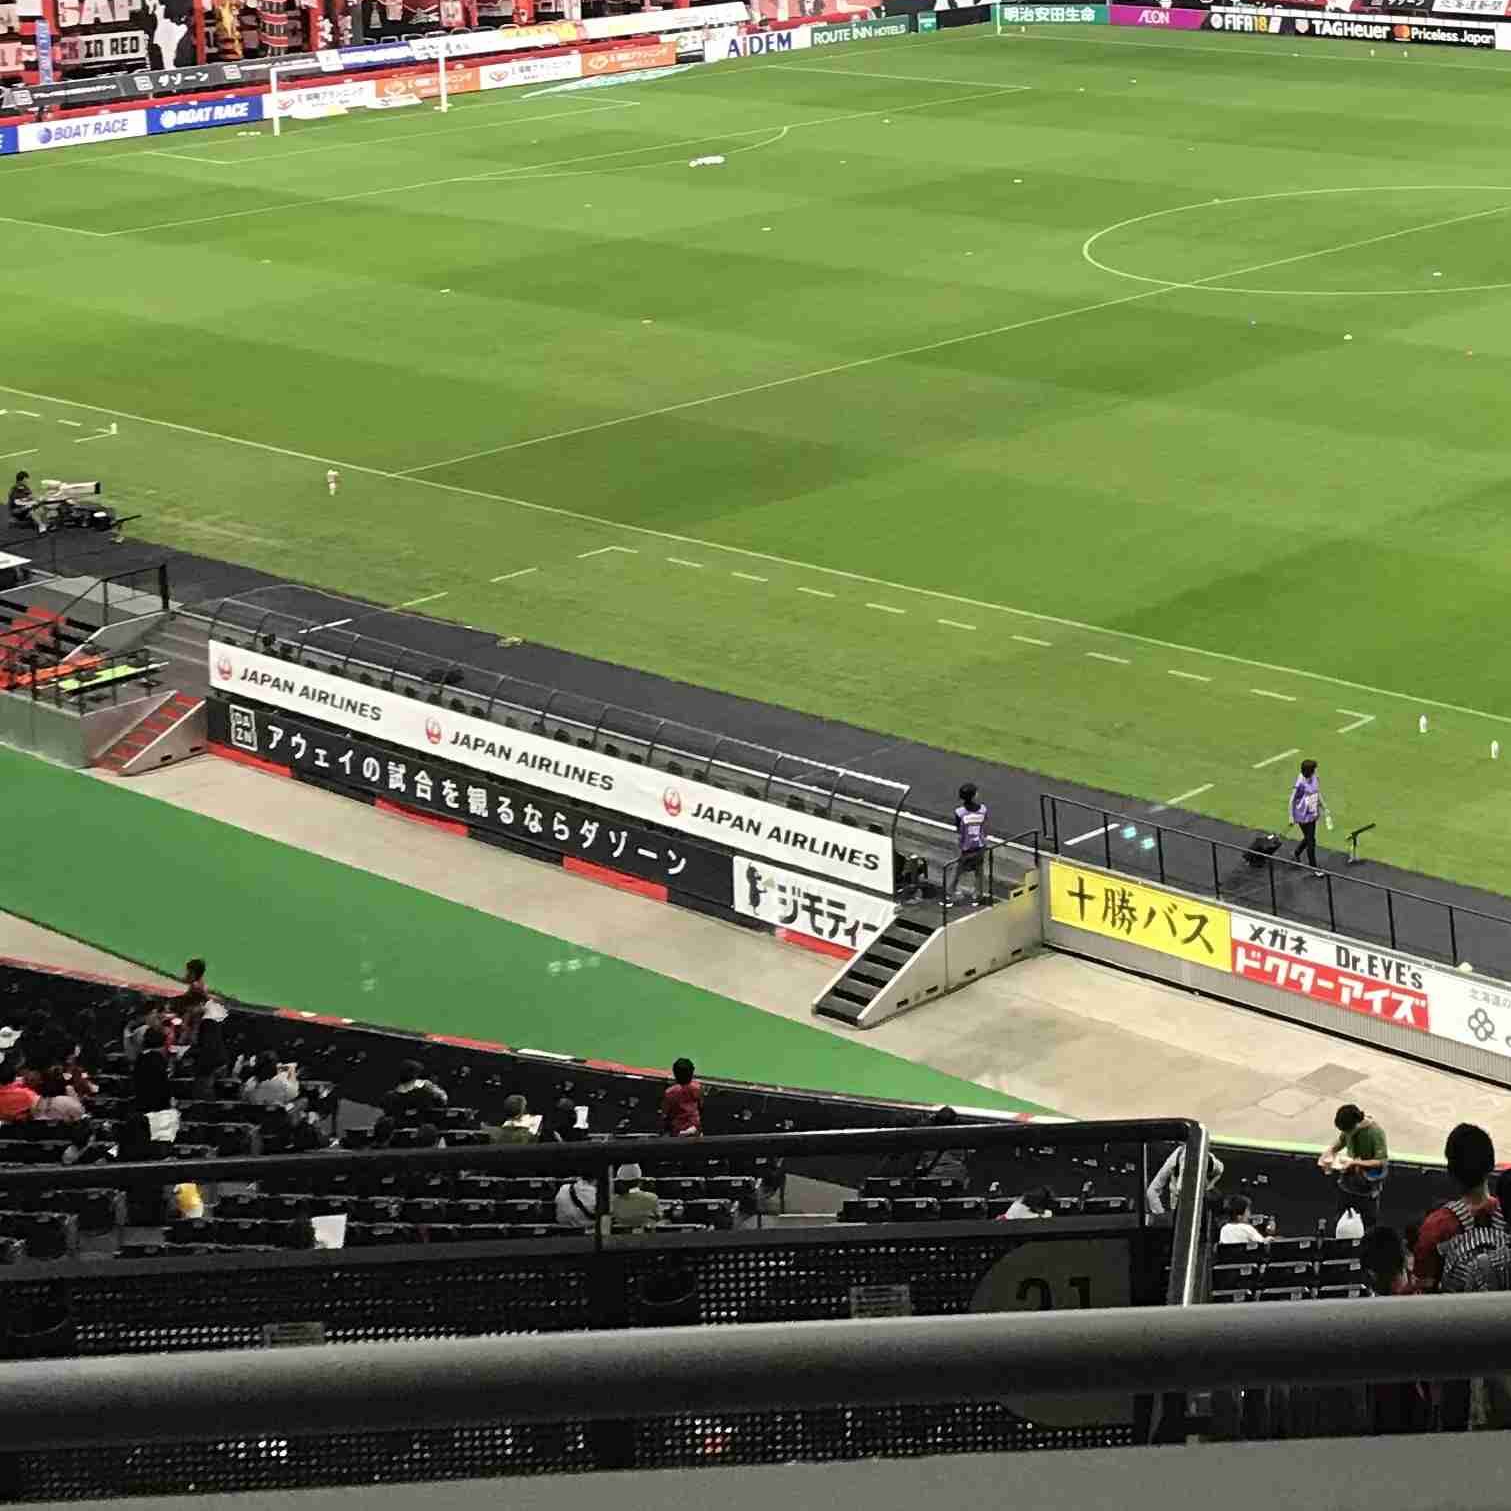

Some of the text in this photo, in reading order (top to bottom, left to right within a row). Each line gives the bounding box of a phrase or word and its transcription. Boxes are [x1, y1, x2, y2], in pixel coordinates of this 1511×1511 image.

[813, 28, 851, 46] ROUTE
[874, 23, 906, 37] HOTELS
[1004, 5, 1096, 23] 明治安田生命
[54, 117, 129, 141] BOAT RACE
[176, 101, 249, 125] BOAT RACE
[239, 666, 384, 723] JAPAN AIRLINES
[448, 730, 615, 791] JAPAN AIRLINES
[690, 801, 881, 872] JAPAN AIRLINES
[775, 883, 881, 947] ジモティー
[1067, 876, 1216, 955] 十勝バス
[1247, 923, 1309, 956] メガネ
[1235, 948, 1427, 1024] ドクターアイズ
